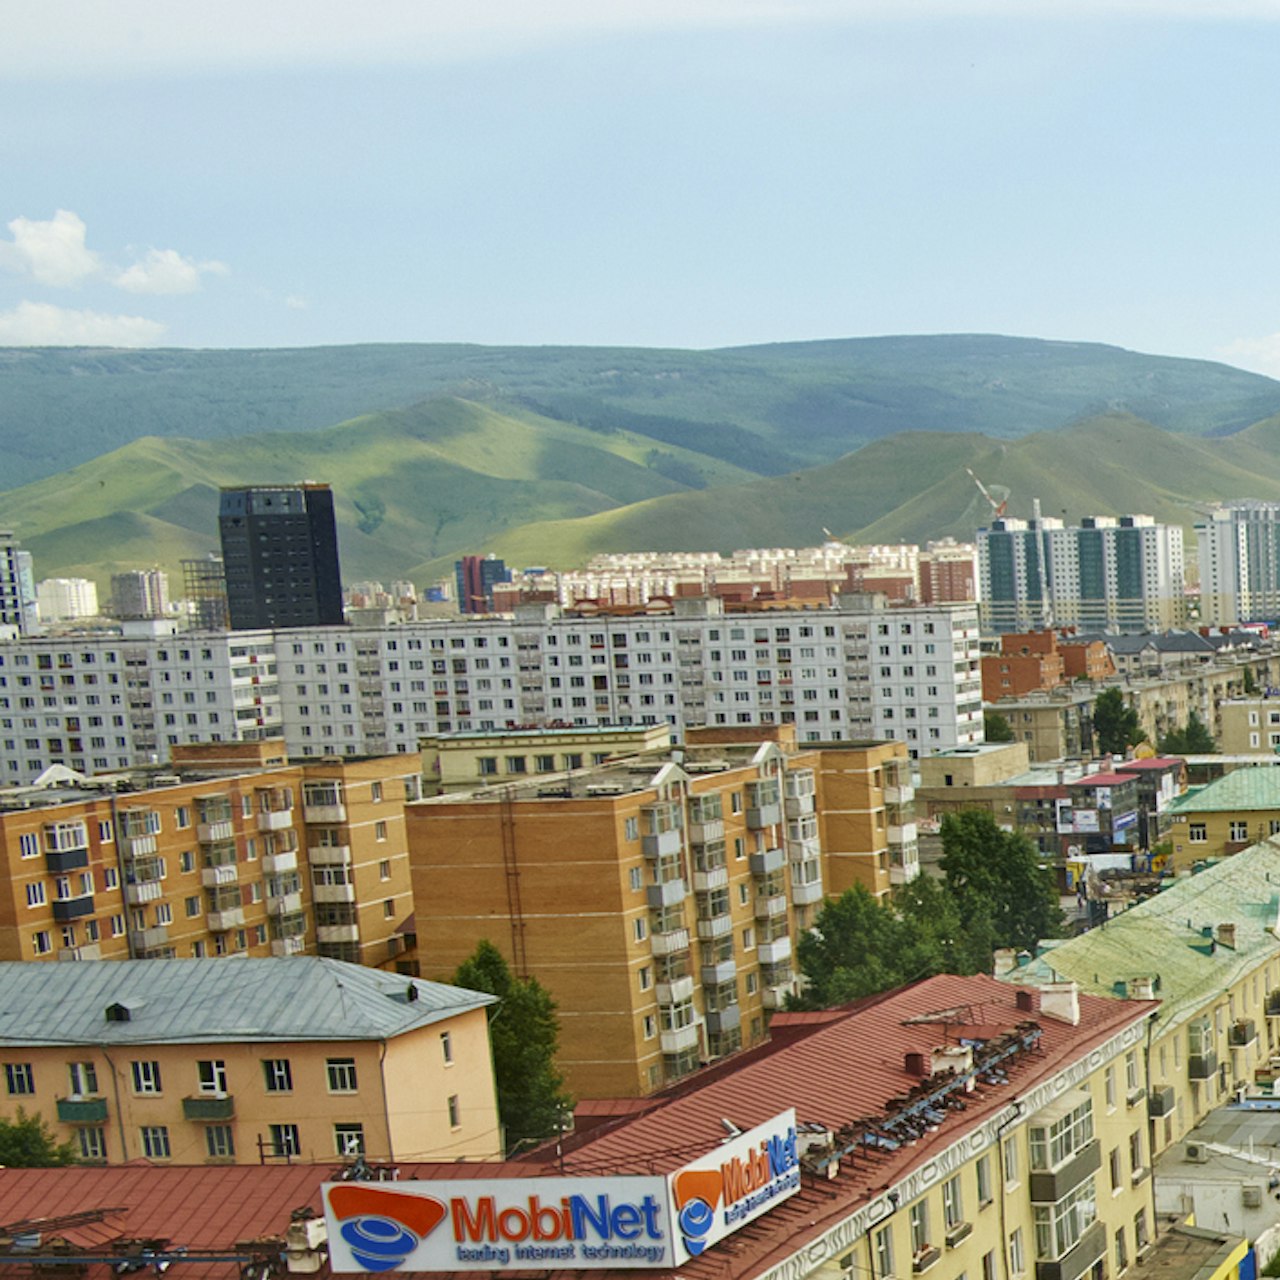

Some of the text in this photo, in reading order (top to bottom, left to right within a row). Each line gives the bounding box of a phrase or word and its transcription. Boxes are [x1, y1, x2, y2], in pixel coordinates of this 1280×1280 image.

[720, 1127, 799, 1207] MobiNet
[449, 1194, 665, 1243] MobiNet
[456, 1244, 666, 1264] leading internet technology
